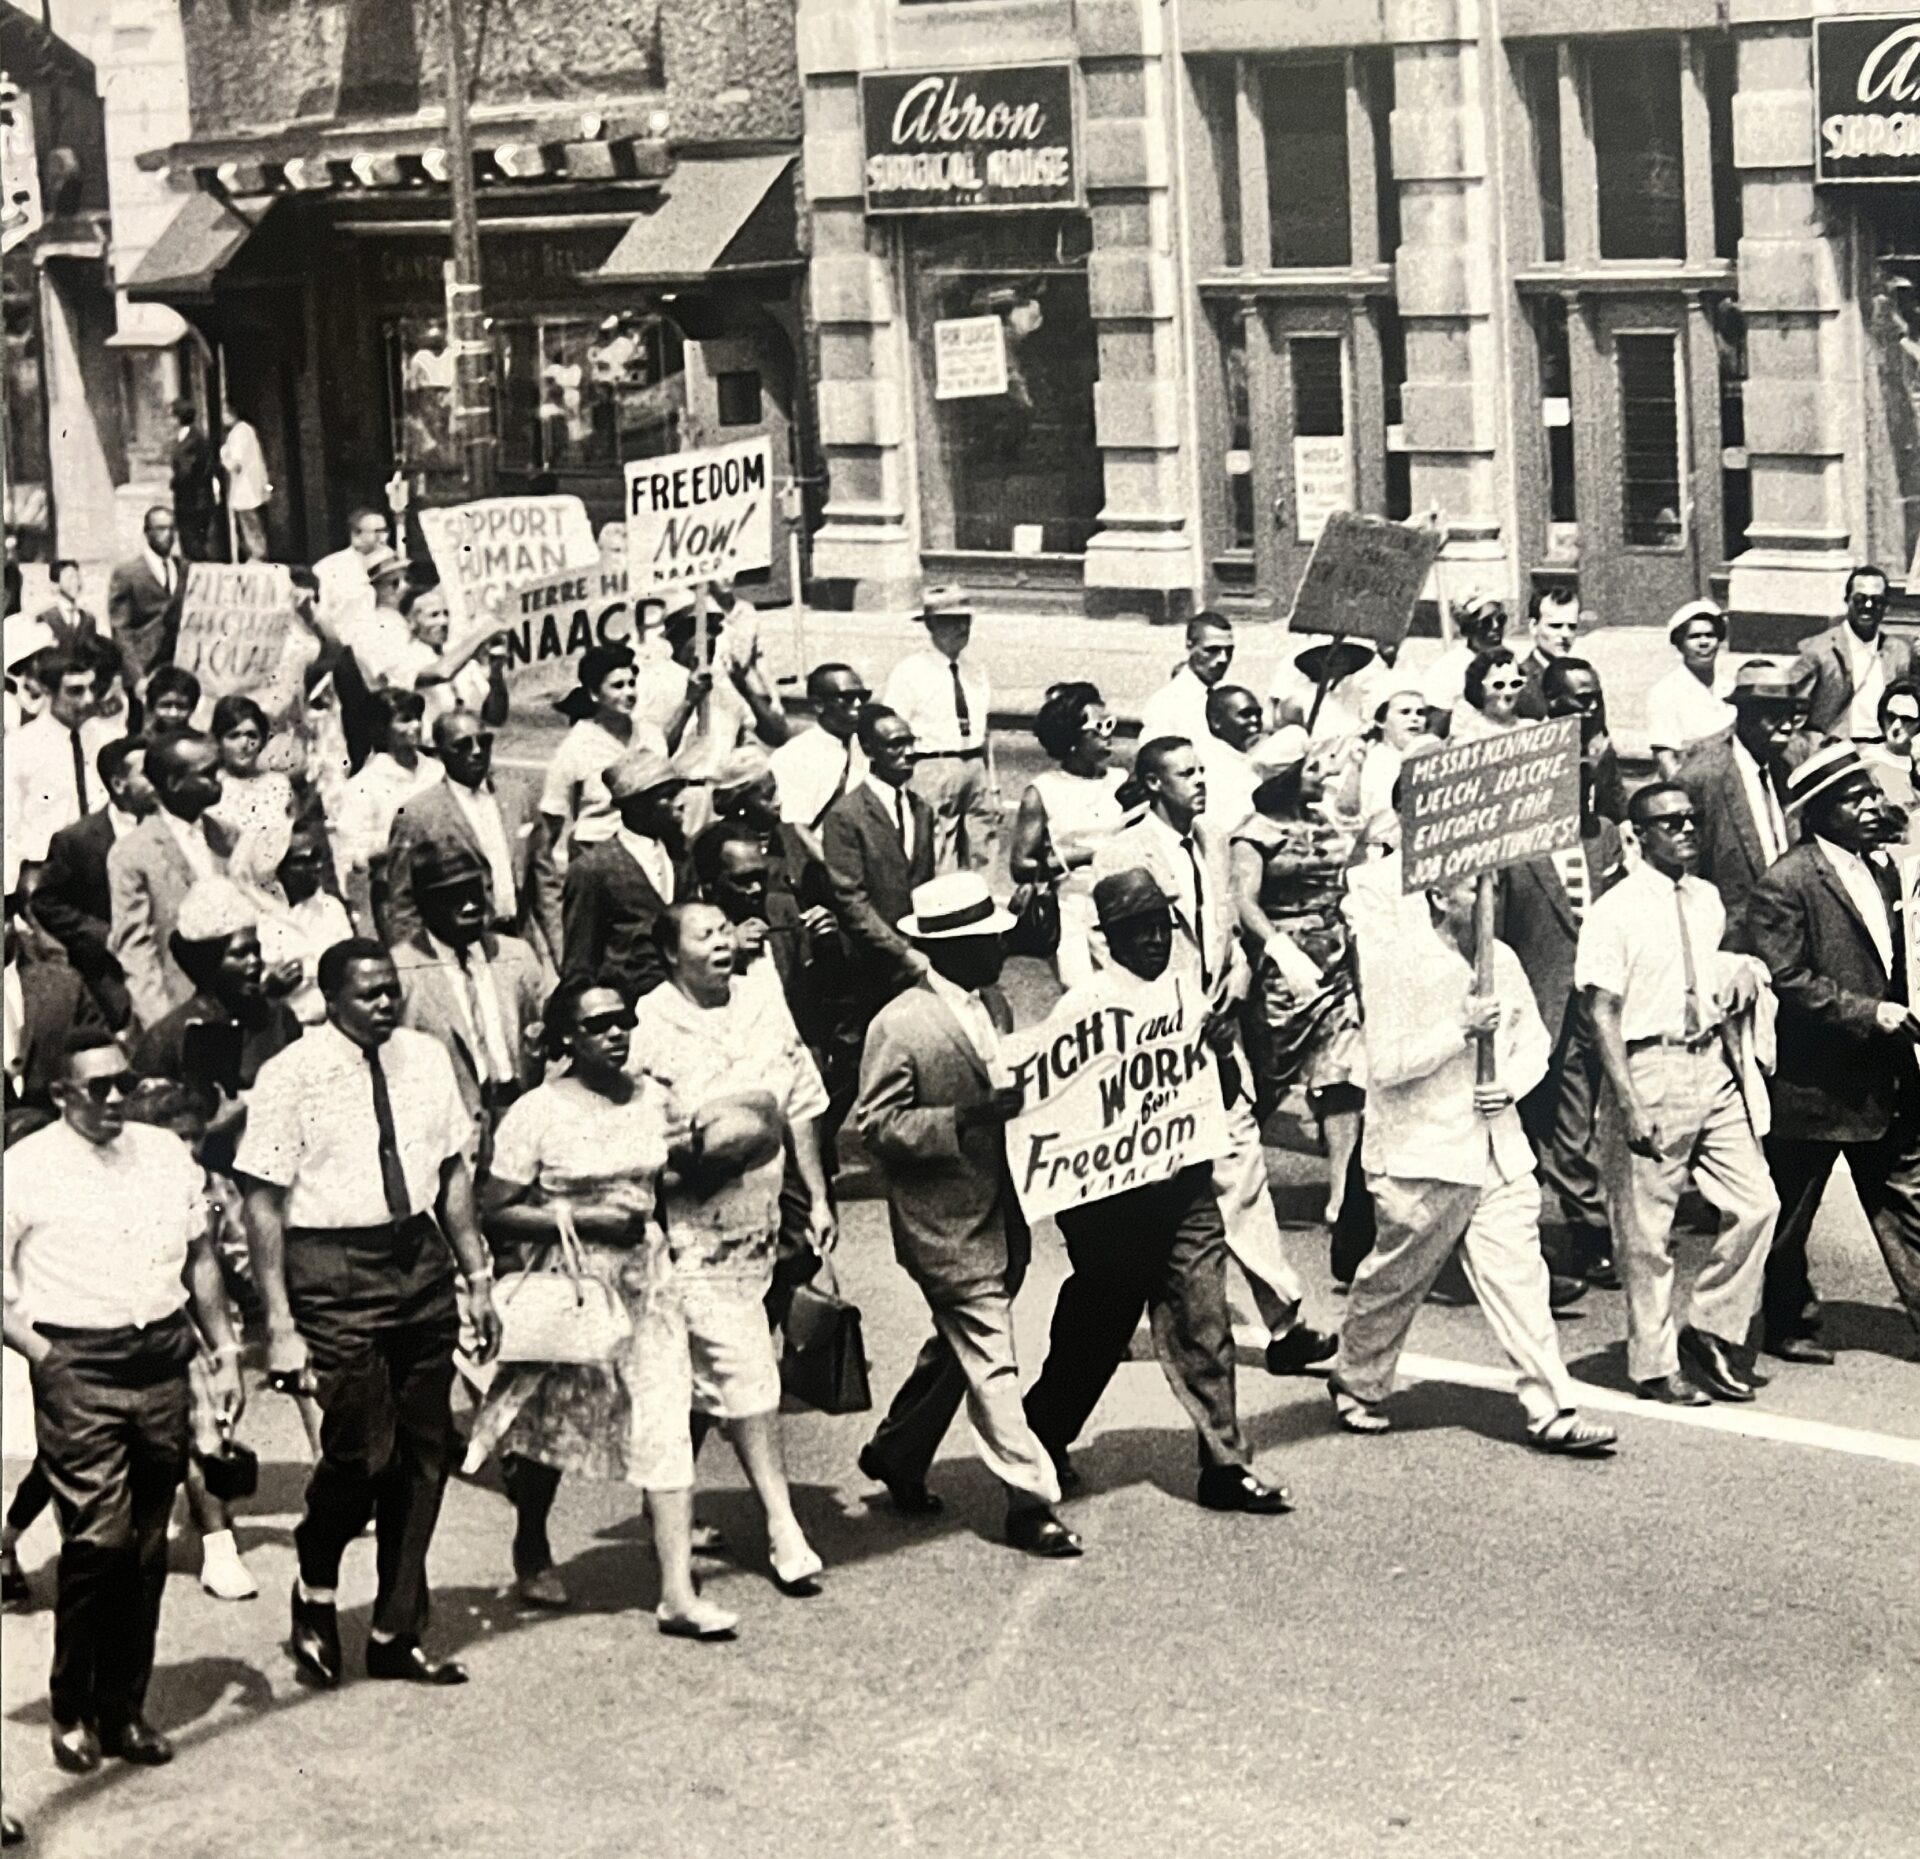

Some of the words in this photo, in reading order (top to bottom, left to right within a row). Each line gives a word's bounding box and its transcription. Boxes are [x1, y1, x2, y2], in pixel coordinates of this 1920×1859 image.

[892, 76, 1046, 144] Akron
[632, 453, 765, 515] FREEDOM
[457, 543, 568, 584] HUMAN
[520, 577, 588, 614] TERRE
[506, 597, 666, 670] NAACP
[1413, 803, 1502, 851] ENFORCE
[1408, 854, 1443, 884] JOB
[1007, 1007, 1134, 1101] FIGHT
[1136, 977, 1183, 1045] and
[1100, 1026, 1207, 1129] WORK
[1023, 1113, 1196, 1194] Freedom
